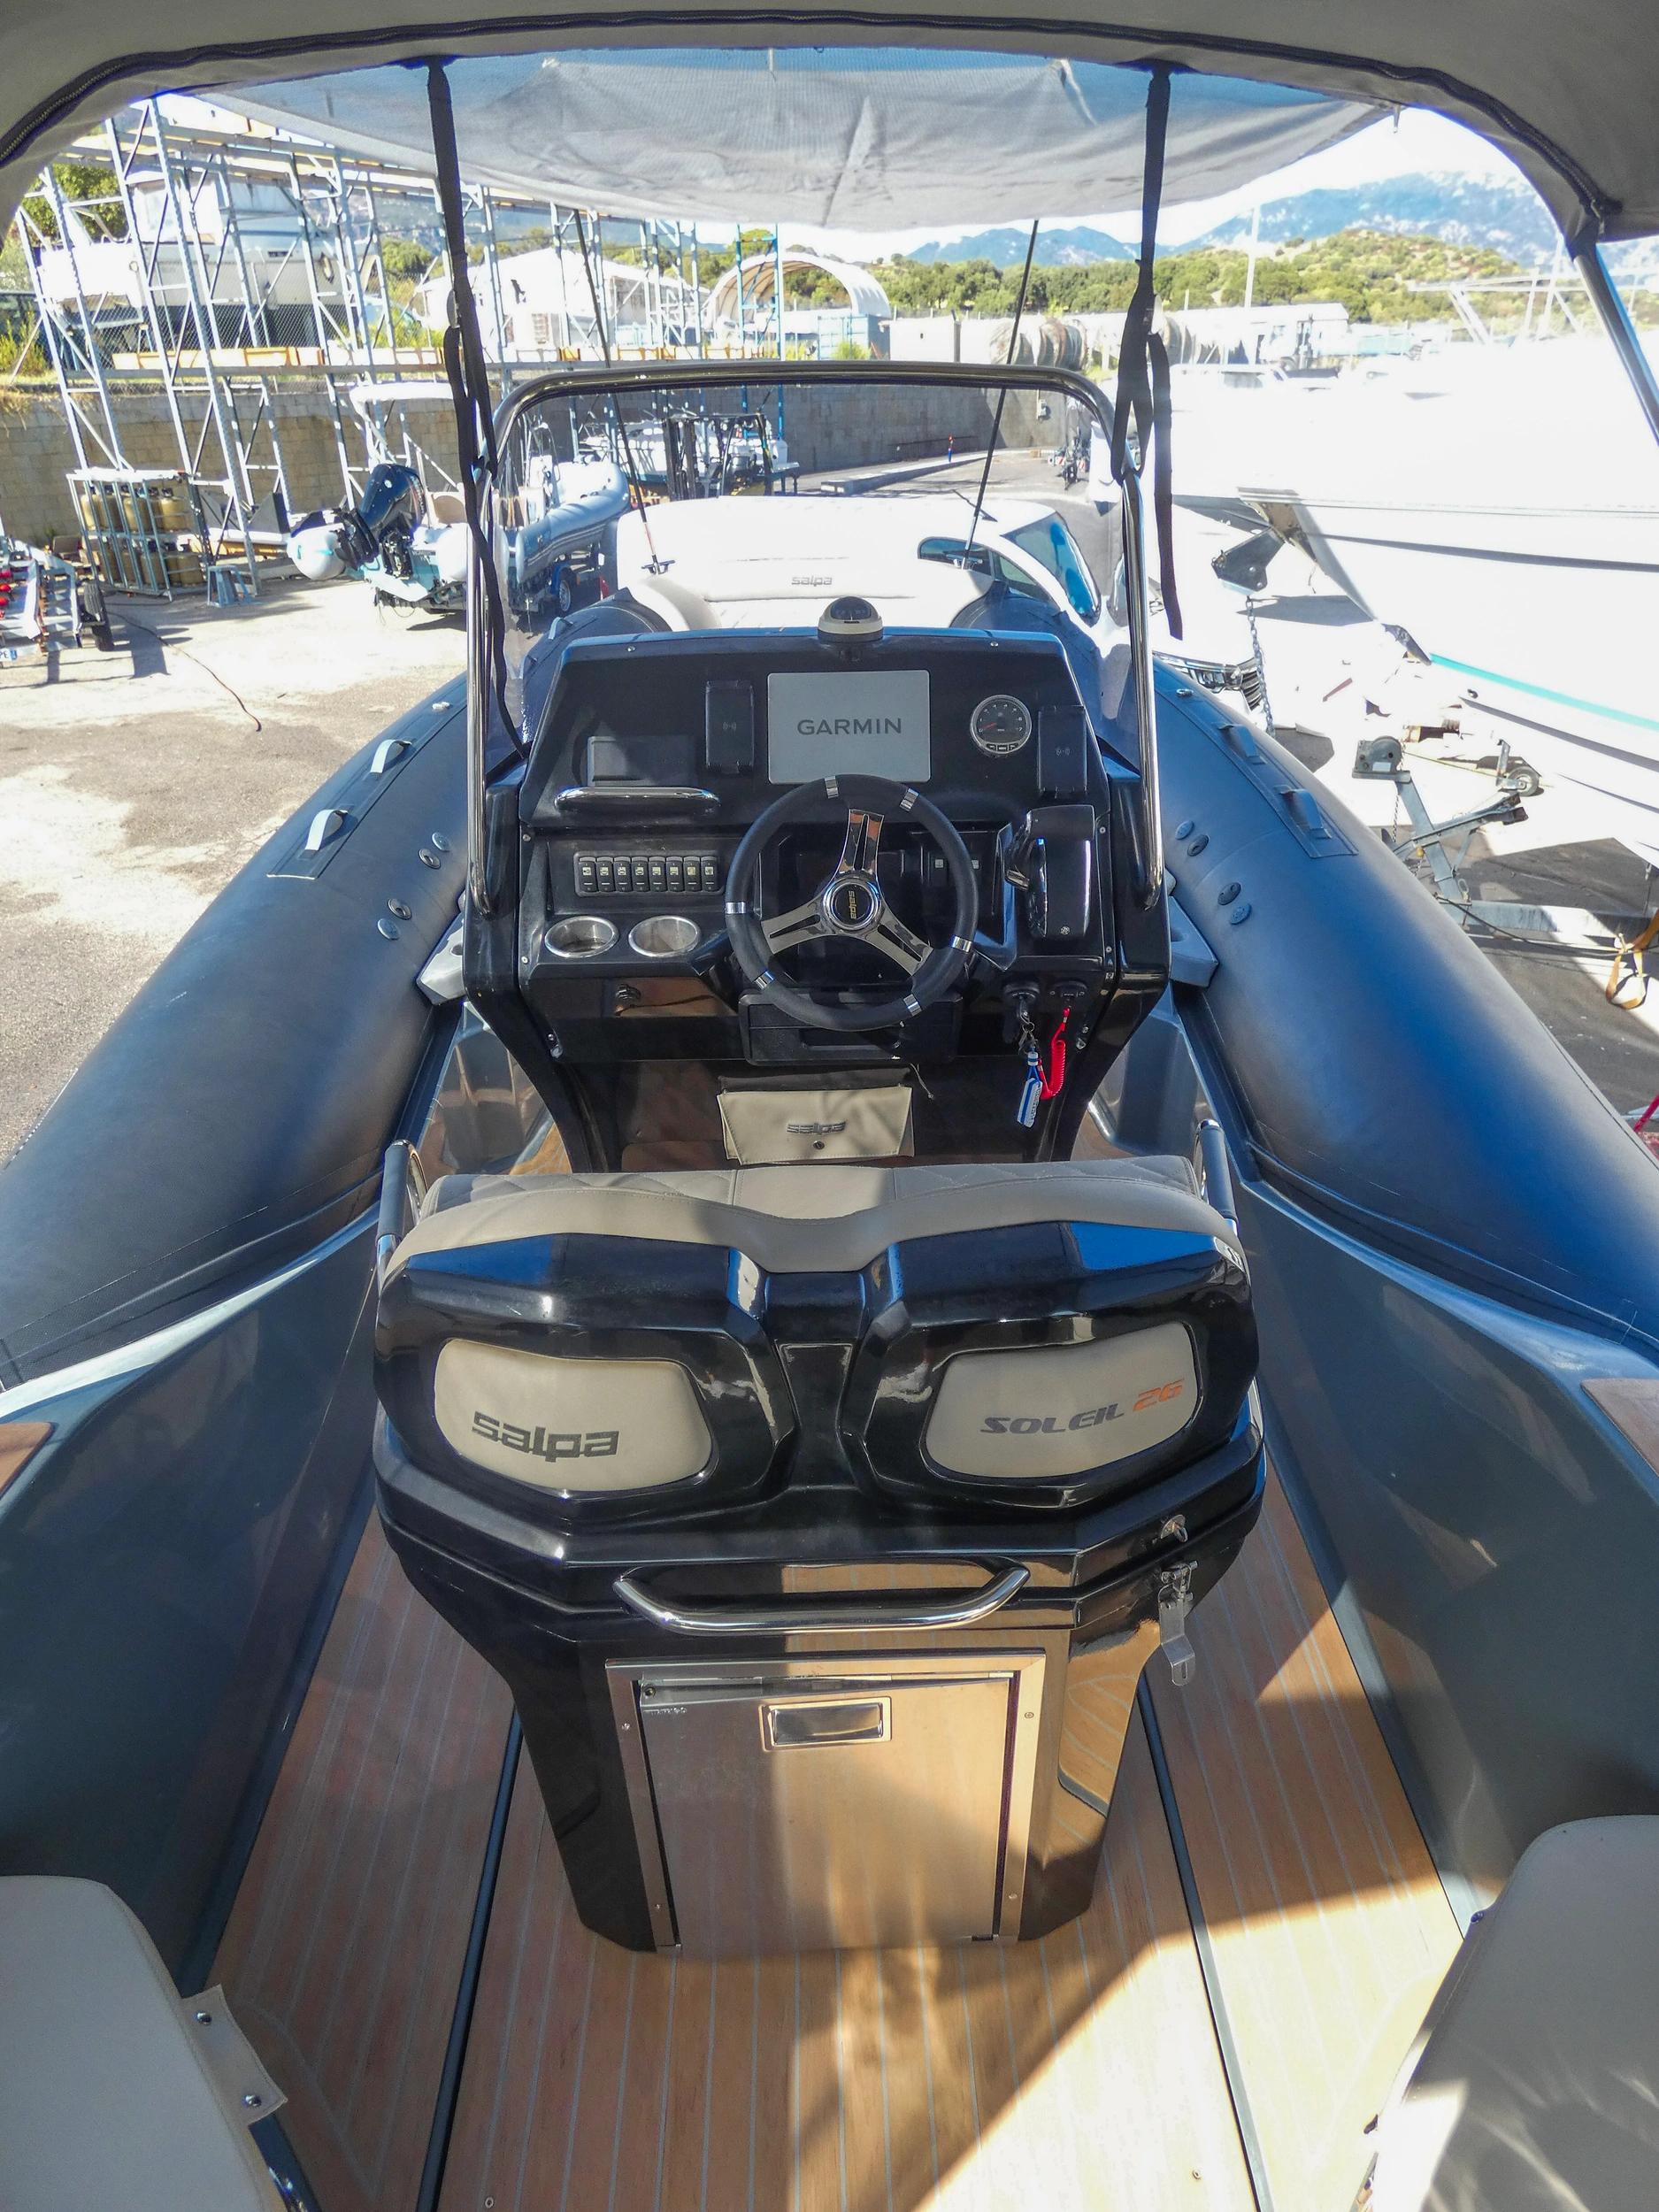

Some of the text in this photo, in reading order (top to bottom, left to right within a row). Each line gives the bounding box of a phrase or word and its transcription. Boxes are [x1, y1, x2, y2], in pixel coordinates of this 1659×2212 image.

[791, 575, 833, 588] salpa
[797, 718, 902, 735] GARMIN
[980, 1378, 1185, 1434] SOLEIL 26
[472, 1410, 620, 1463] salpa
